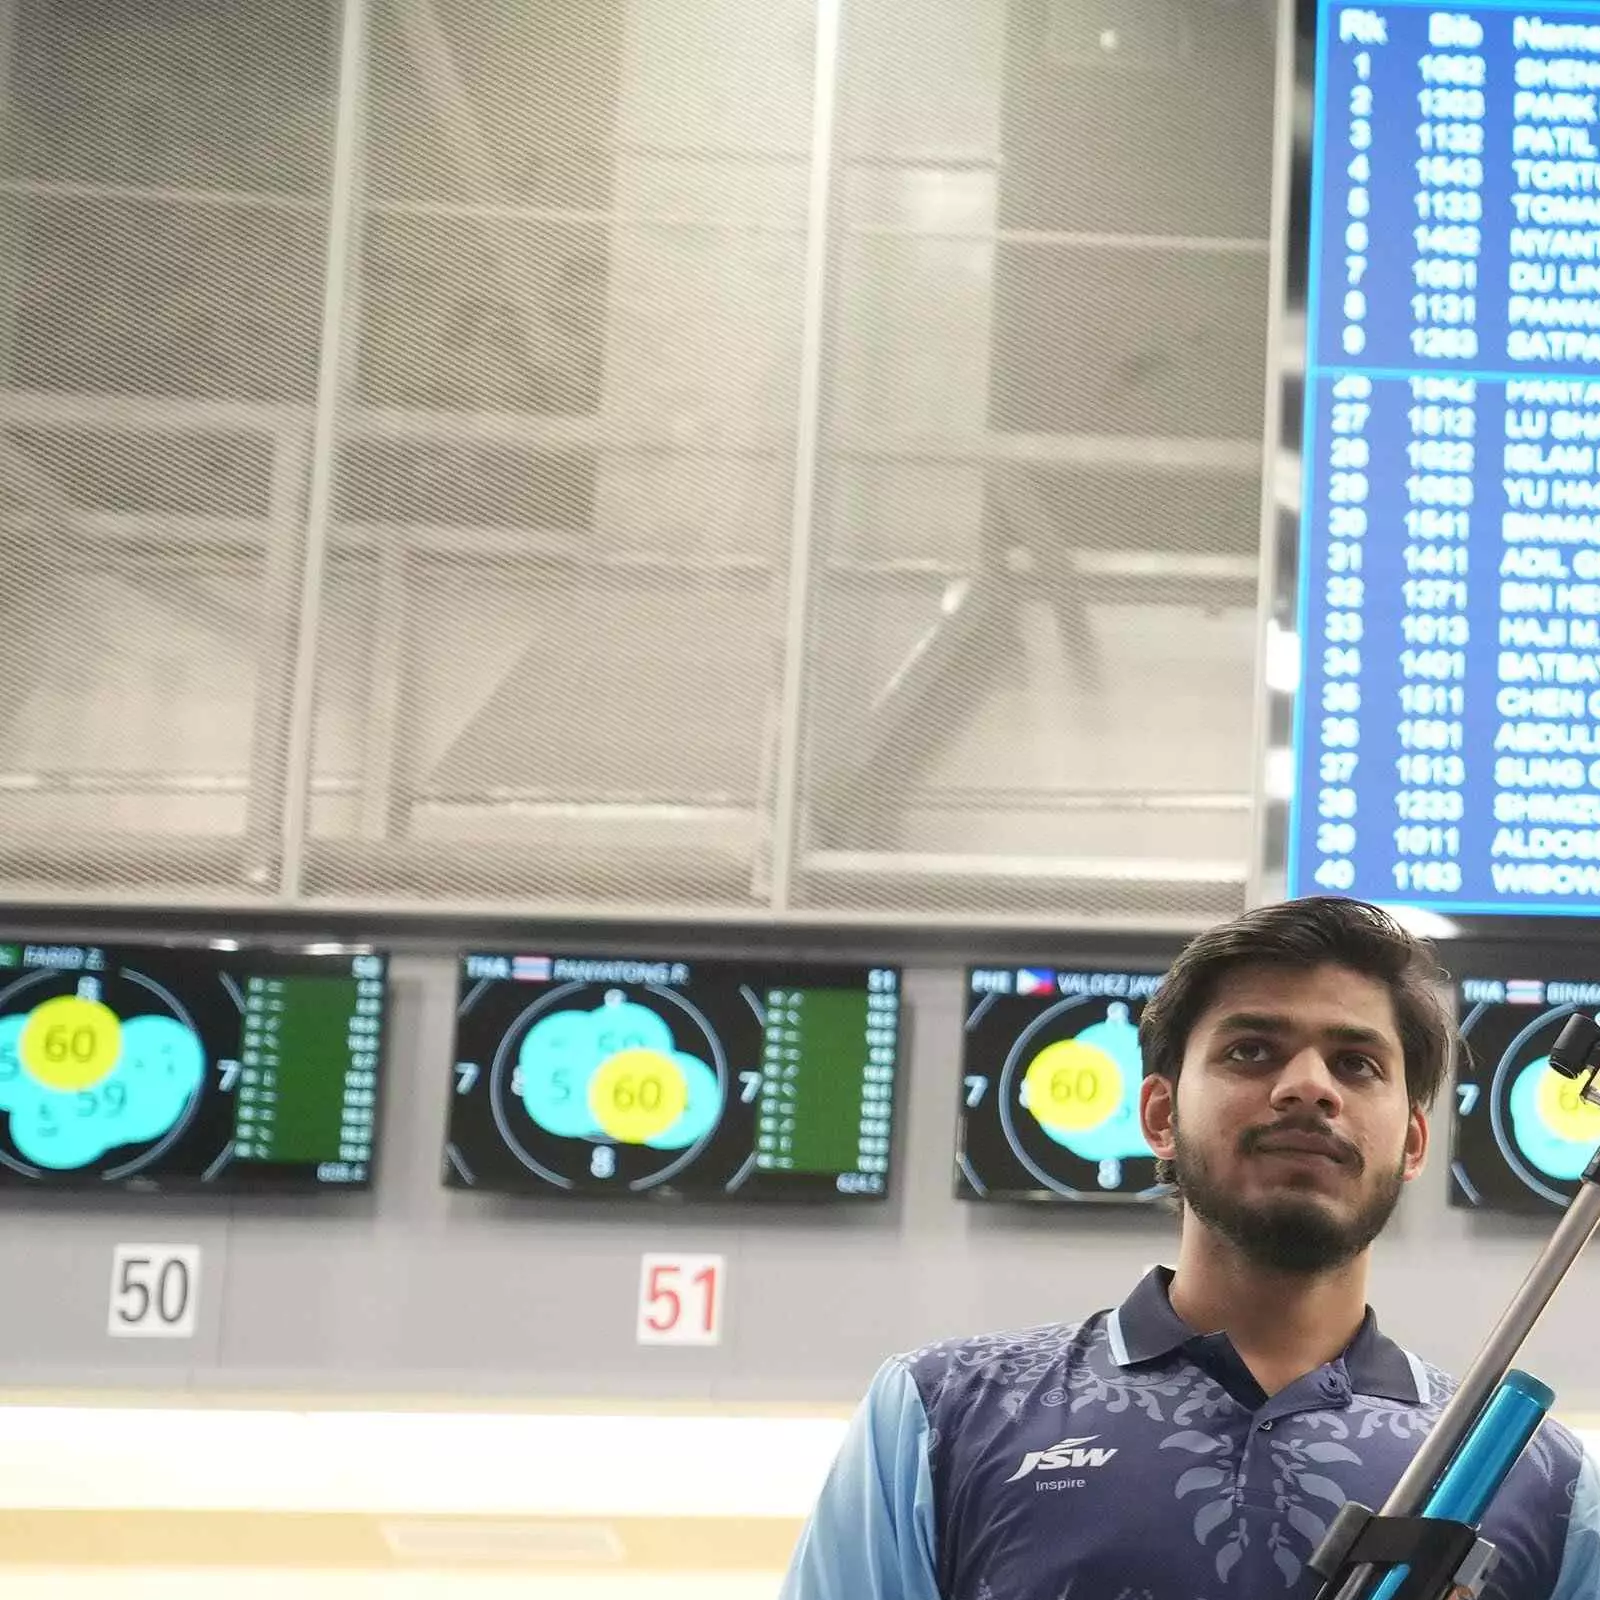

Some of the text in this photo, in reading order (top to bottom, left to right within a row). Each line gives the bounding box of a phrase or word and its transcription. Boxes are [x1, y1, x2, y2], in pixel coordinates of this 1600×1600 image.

[1513, 127, 1595, 158] PATIL
[1348, 154, 1370, 184] 4
[1346, 255, 1368, 285] 7
[1510, 263, 1555, 293] DU
[1505, 409, 1546, 439] LU
[1503, 479, 1548, 508] YU
[44, 1025, 97, 1062] 60
[217, 1060, 241, 1092] 7
[739, 1071, 764, 1103] 7
[1050, 1070, 1098, 1103] 60
[612, 1075, 663, 1112] 60
[1457, 1084, 1480, 1115] 7
[118, 1259, 189, 1323] 50
[646, 1264, 717, 1333] 51
[1004, 1437, 1119, 1484] JSW
[1034, 1475, 1087, 1493] Inspire
